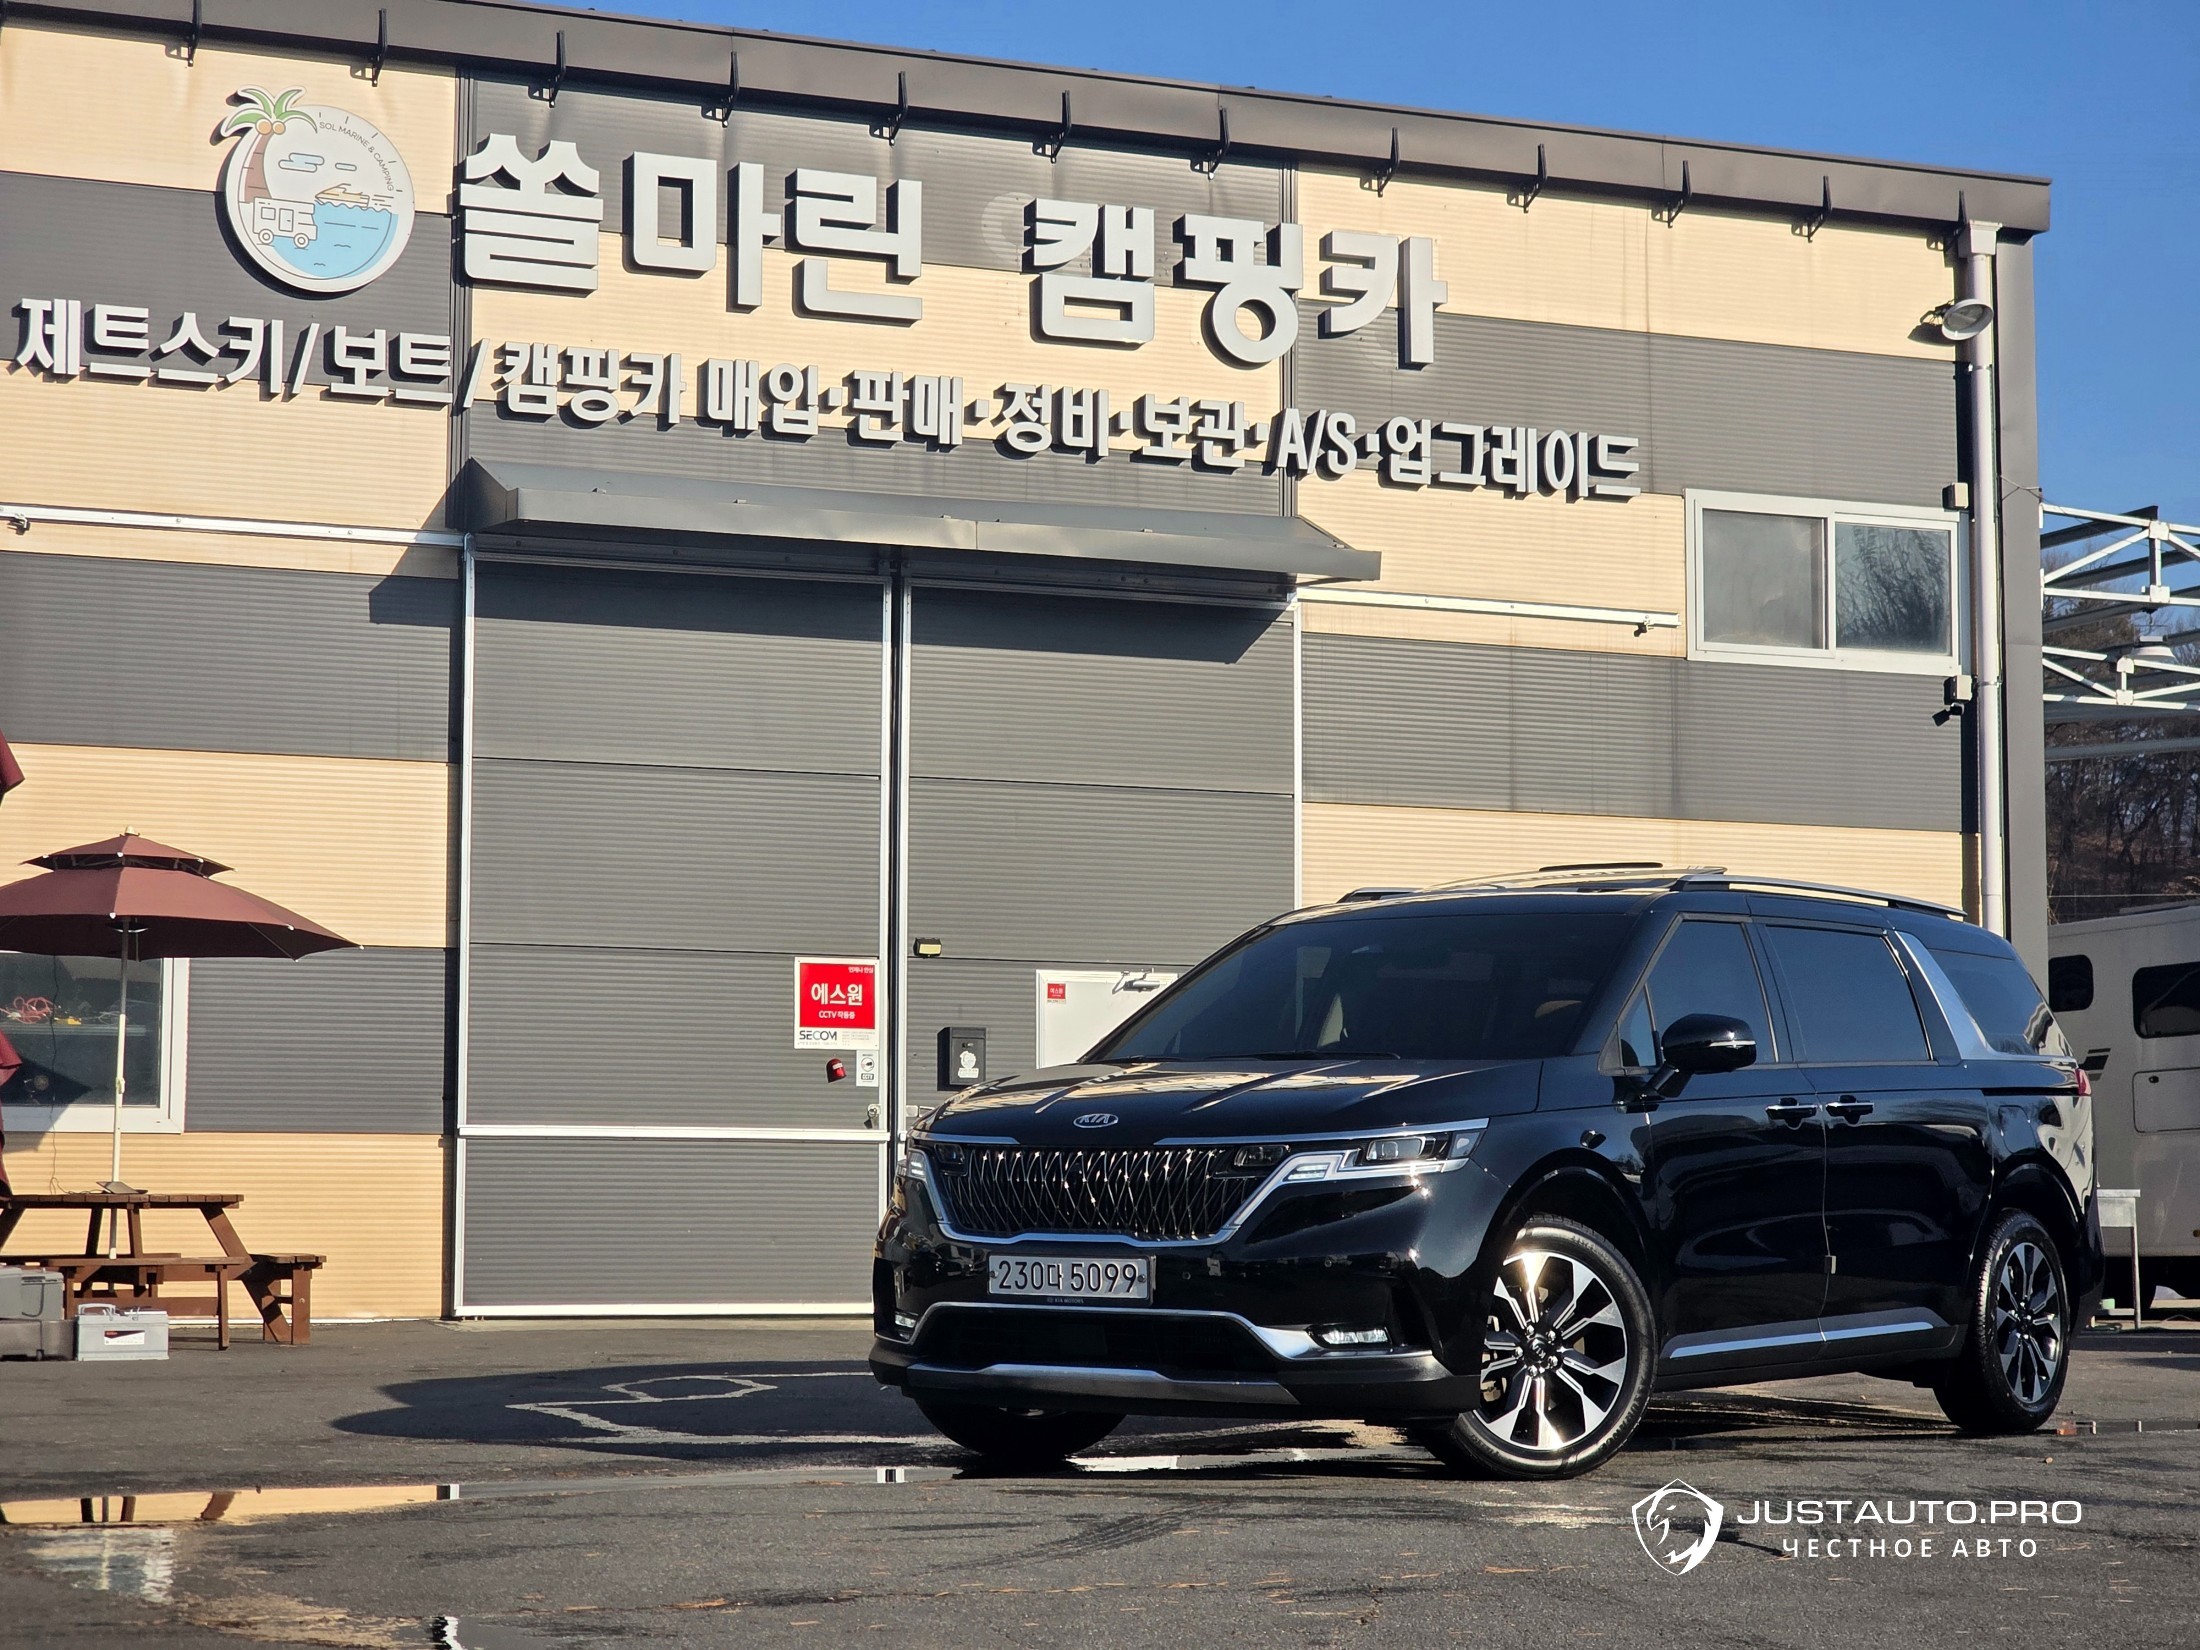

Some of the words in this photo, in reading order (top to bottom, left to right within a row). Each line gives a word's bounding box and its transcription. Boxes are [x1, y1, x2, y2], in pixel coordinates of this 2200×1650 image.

[319, 121, 337, 131] SOL
[338, 125, 370, 147] MARINE
[373, 152, 394, 191] CAMPING
[459, 133, 922, 321] 쏠마린
[1021, 198, 1448, 366] 캠핑카
[811, 983, 863, 1006] 에스원
[818, 1010, 837, 1019] CCTV
[799, 1030, 837, 1040] SECOM
[1079, 1114, 1110, 1123] KIA
[999, 1260, 1063, 1291] 230다
[1071, 1262, 1139, 1293] 5099
